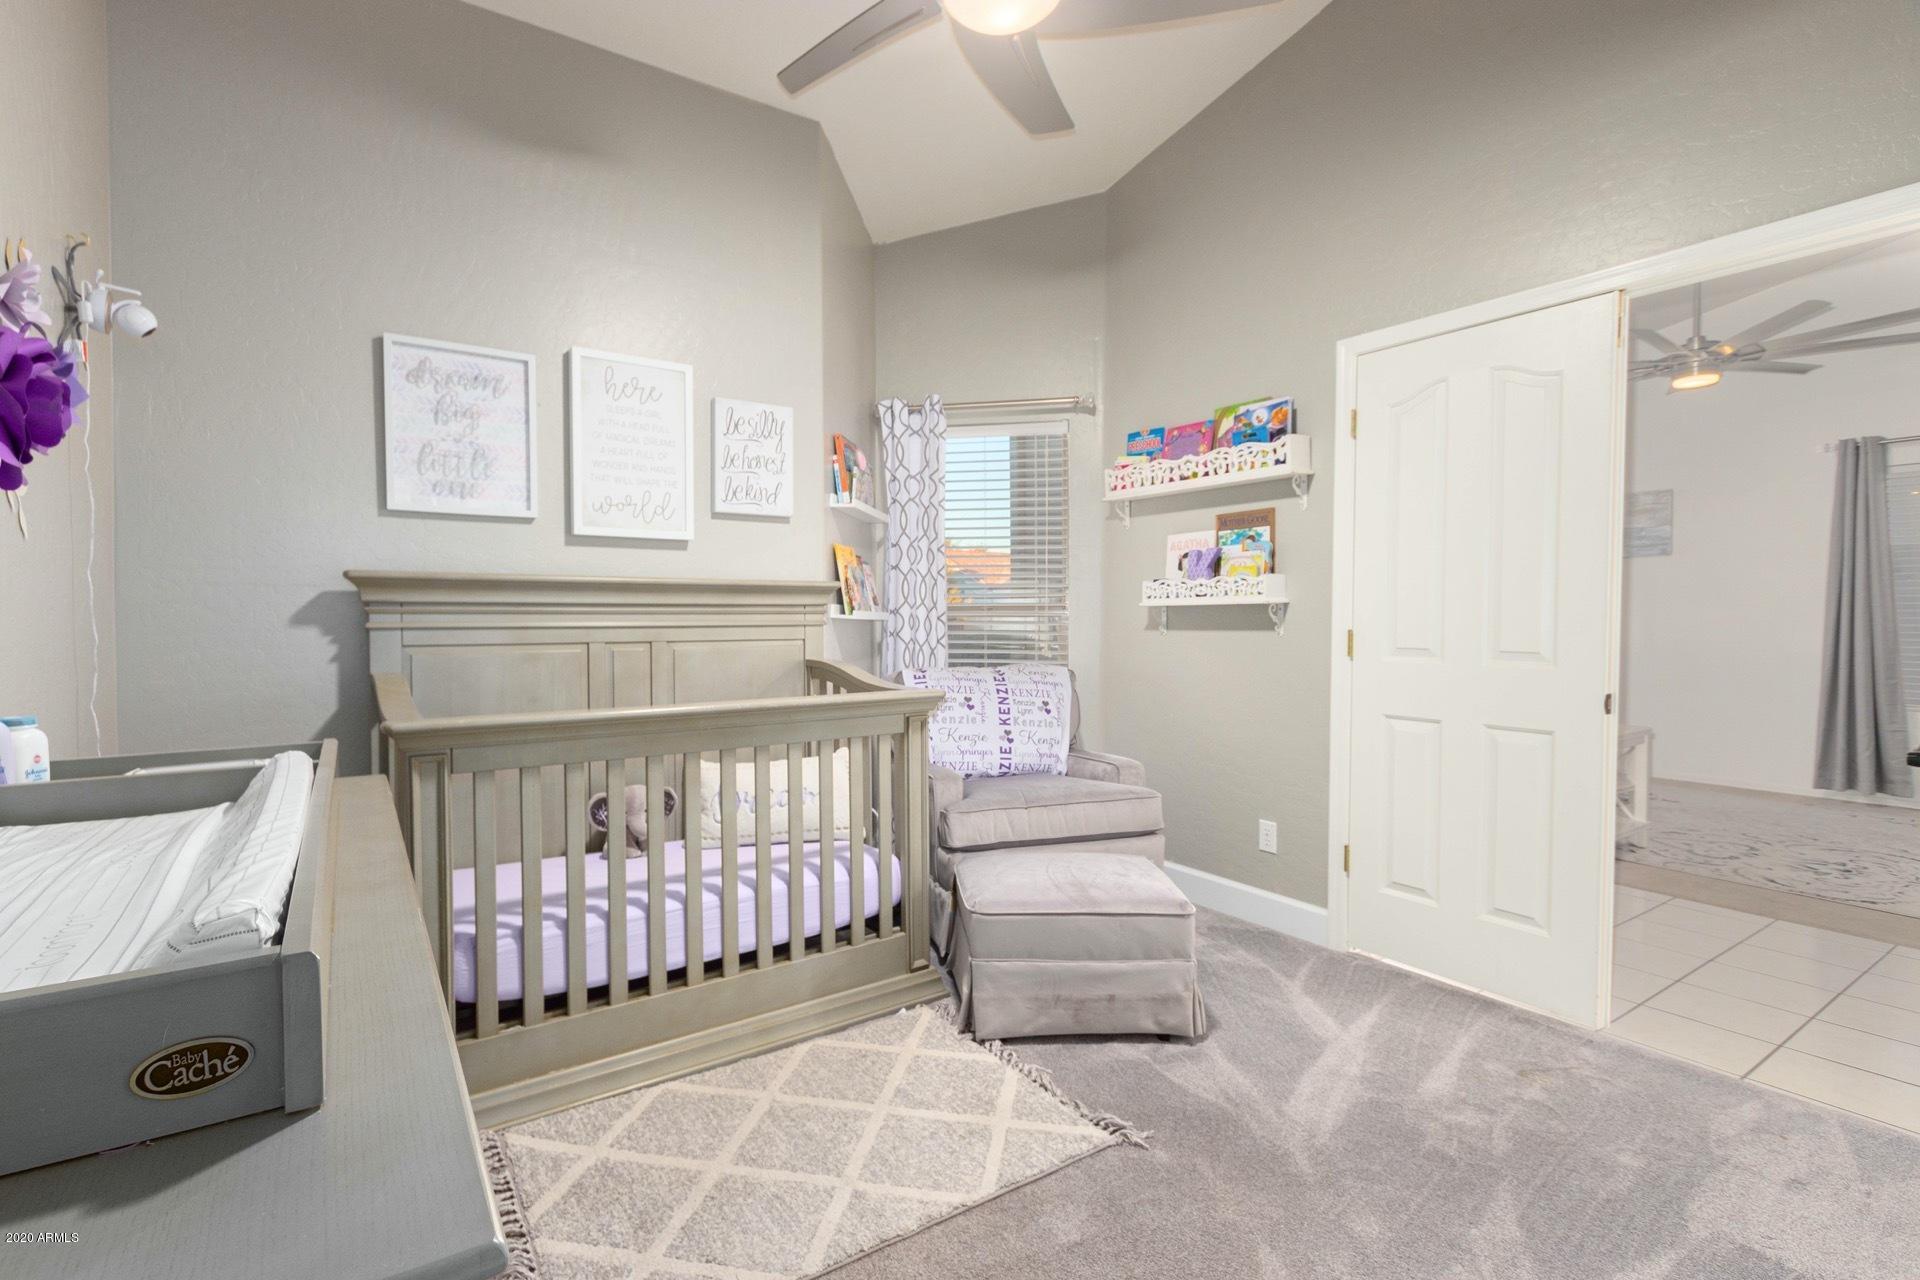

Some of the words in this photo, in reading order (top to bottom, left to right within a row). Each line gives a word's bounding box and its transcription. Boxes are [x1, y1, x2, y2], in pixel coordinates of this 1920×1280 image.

[604, 365, 664, 405] here
[722, 406, 746, 436] be
[747, 409, 786, 454] silly
[721, 444, 740, 470] be
[741, 444, 786, 475] honest
[591, 489, 676, 524] world
[721, 476, 744, 502] be
[744, 476, 783, 505] kind
[993, 675, 1011, 726] KENZIE
[1011, 688, 1053, 699] KENZIE
[938, 727, 988, 746] Kenzie
[144, 1045, 240, 1091] Caché
[172, 1051, 202, 1067] Baby
